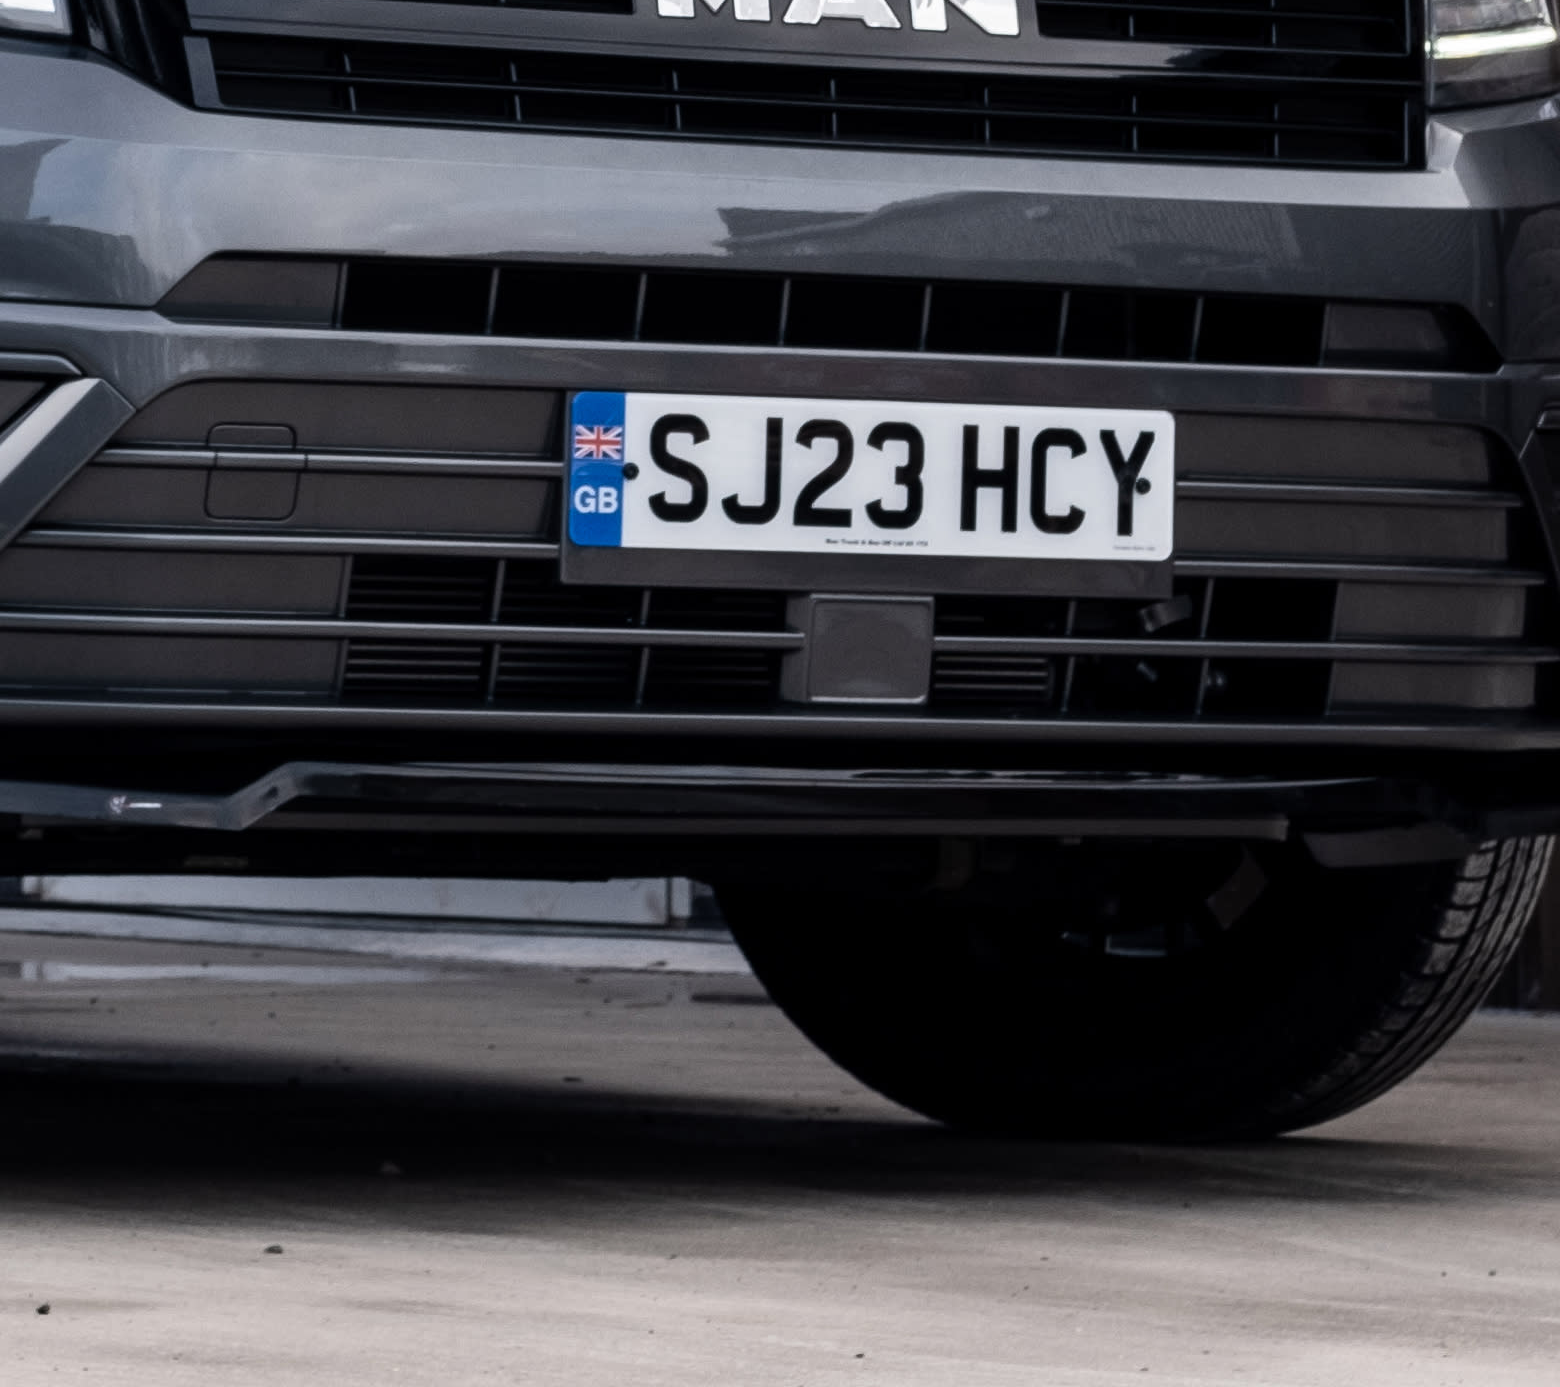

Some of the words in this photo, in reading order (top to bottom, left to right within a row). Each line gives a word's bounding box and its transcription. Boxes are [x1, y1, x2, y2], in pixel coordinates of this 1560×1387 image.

[574, 486, 618, 514] GB
[648, 413, 926, 530] SJ23
[959, 423, 1156, 537] HCY
